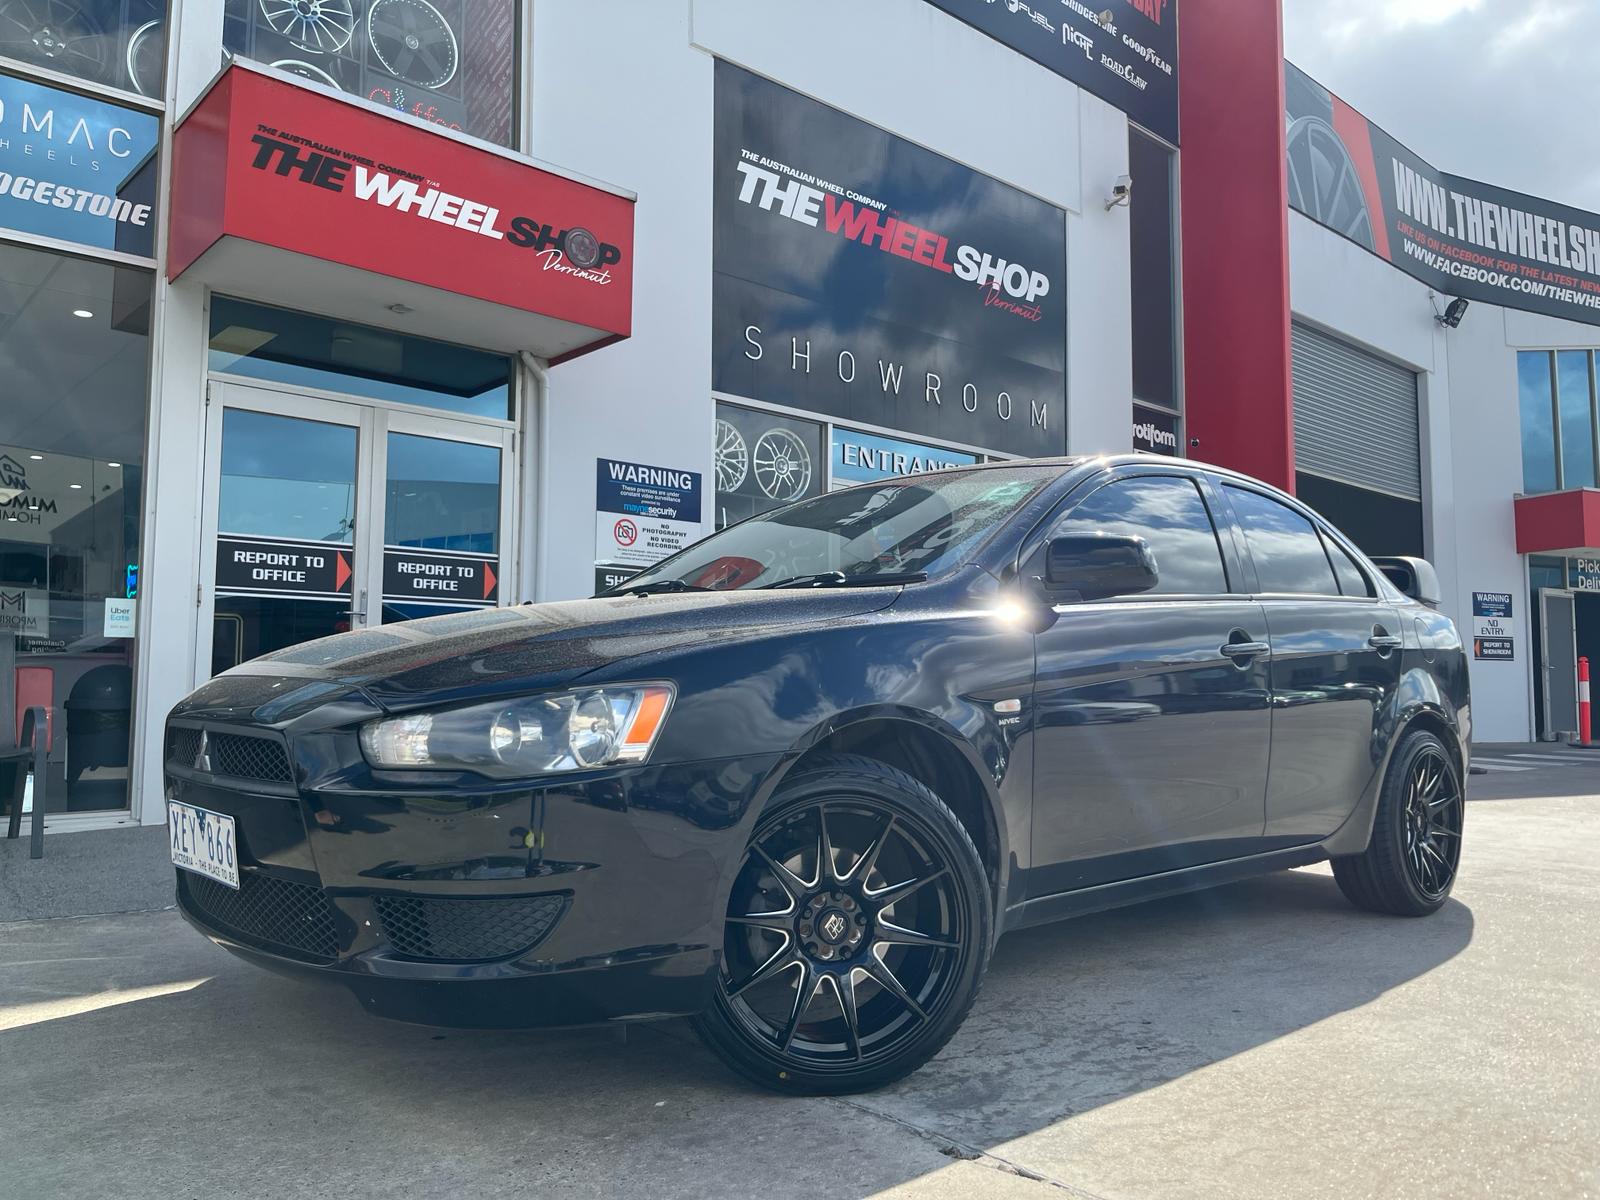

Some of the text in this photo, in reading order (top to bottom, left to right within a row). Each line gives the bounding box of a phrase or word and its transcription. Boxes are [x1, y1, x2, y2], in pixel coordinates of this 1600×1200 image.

[1018, 2, 1056, 31] FUEL
[1060, 0, 1118, 37] BRIDGESONE
[1122, 33, 1172, 76] GOODYEAR
[257, 124, 278, 137] THE
[278, 130, 342, 157] AUSTRALIAN
[343, 151, 376, 168] WHEEL
[377, 162, 425, 182] COMPANY
[741, 149, 759, 162] THE
[760, 156, 816, 184] AUSTRALIAN
[816, 179, 845, 196] WHEEL
[846, 190, 888, 211] COMPANY
[251, 133, 622, 270] THE WHEEL SHOP
[737, 160, 1050, 303] THE WHEEL SHOP
[536, 248, 612, 285] Derrimut
[1397, 219, 1414, 238] LIKE
[1415, 231, 1426, 245] US
[1427, 237, 1439, 251] ON
[1440, 243, 1495, 268] FACEBOOK
[1496, 260, 1518, 273] FOR
[1519, 265, 1540, 279] THE
[1540, 270, 1578, 288] LATEST
[978, 281, 1042, 322] Derrimut
[744, 325, 1048, 431] SHOWROOM
[1132, 423, 1177, 448] rotiform
[608, 462, 692, 490] WARNING
[622, 484, 636, 492] These
[636, 487, 658, 495] premises
[642, 528, 687, 537] PHOTOGRAPHY
[646, 541, 682, 550] RECORDING
[660, 537, 679, 545] VIDEO
[234, 550, 324, 568] REPORT TO
[398, 562, 474, 578] REPORT TO
[252, 568, 306, 583] OFFICE
[413, 577, 458, 591] OFFICE
[1476, 593, 1510, 603] WARNING
[1481, 627, 1505, 635] ENTRY
[998, 717, 1020, 726] MIVEC
[172, 810, 233, 869] XEY 866
